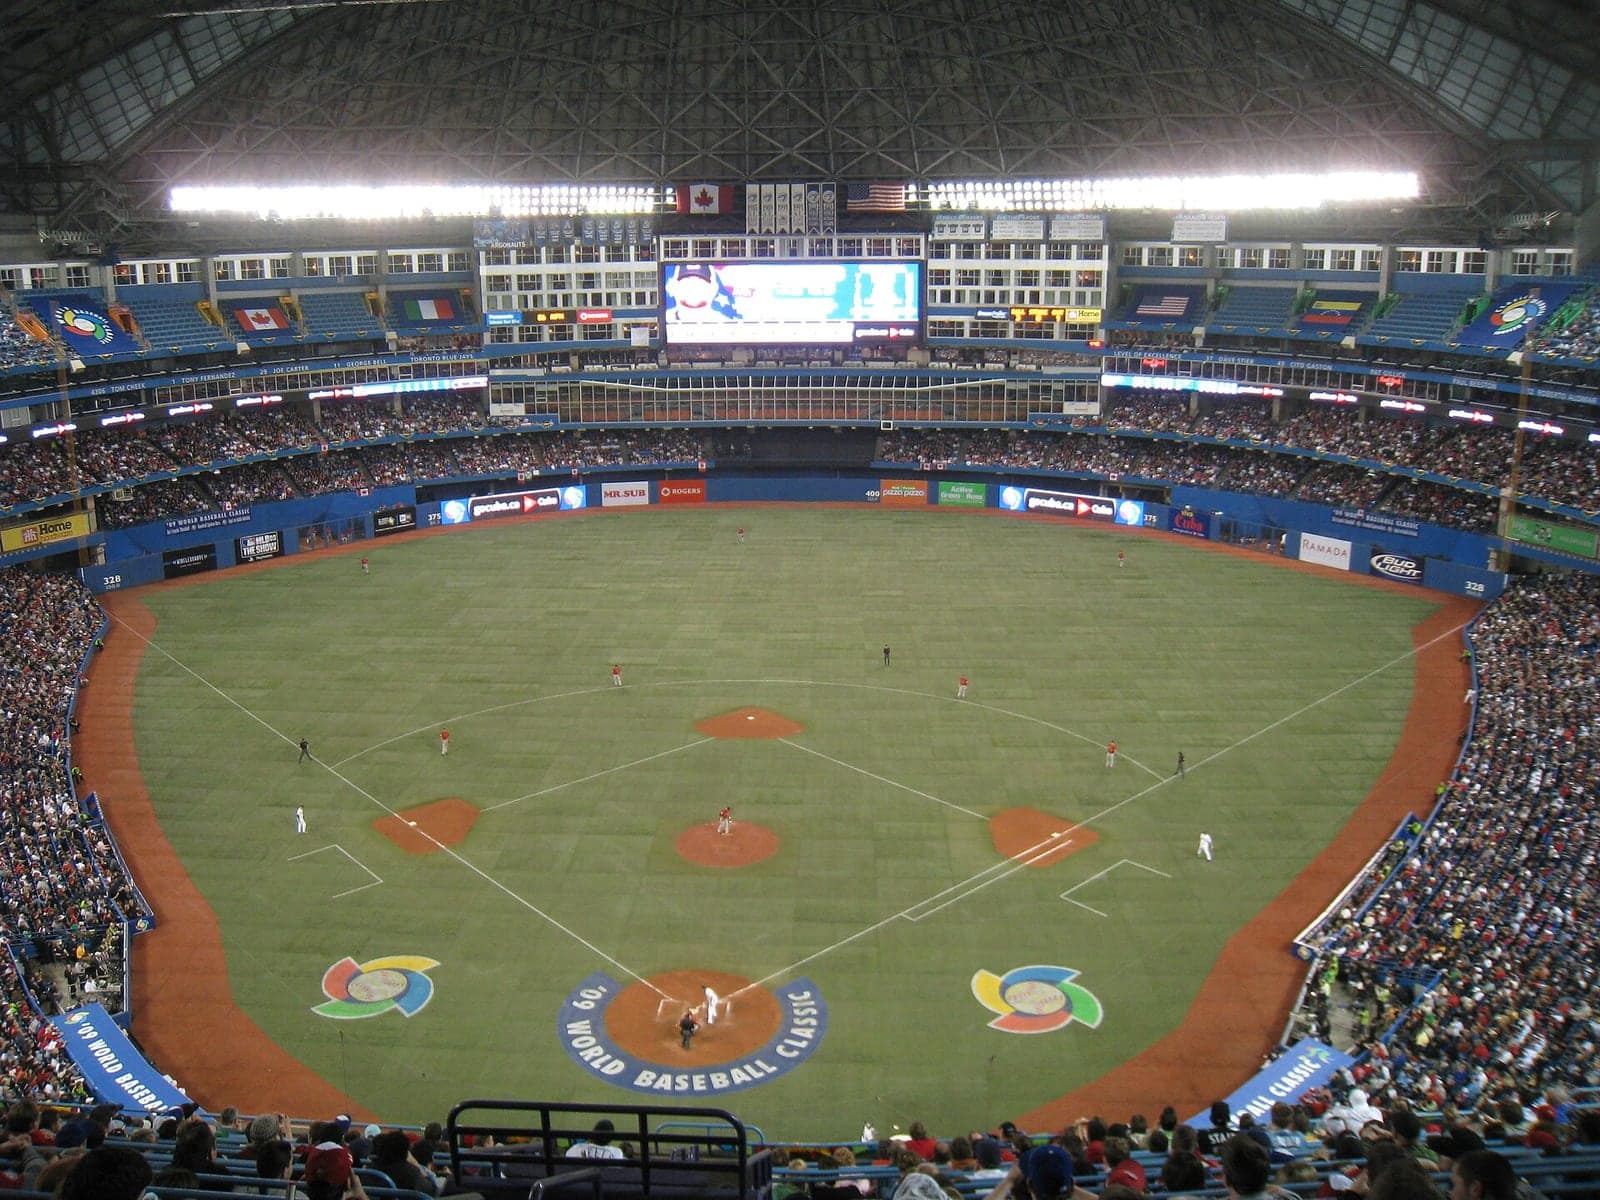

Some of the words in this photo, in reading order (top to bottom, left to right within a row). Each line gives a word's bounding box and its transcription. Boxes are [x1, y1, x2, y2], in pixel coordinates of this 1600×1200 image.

[428, 513, 441, 521] 375
[1143, 514, 1157, 522] 375
[38, 520, 72, 535] Home
[243, 546, 255, 556] THE
[256, 541, 277, 554] SHOW
[1376, 561, 1422, 577] LIGHT
[1383, 556, 1417, 568] BUD
[103, 575, 121, 585] 328
[1464, 581, 1485, 592] 328
[77, 1022, 98, 1041] '09
[88, 1038, 123, 1074] WORLD
[566, 1019, 626, 1075] WORLD
[633, 1058, 777, 1091] BASEBALL
[775, 990, 817, 1058] CLASSIC
[1269, 1055, 1322, 1097] CLASSIC
